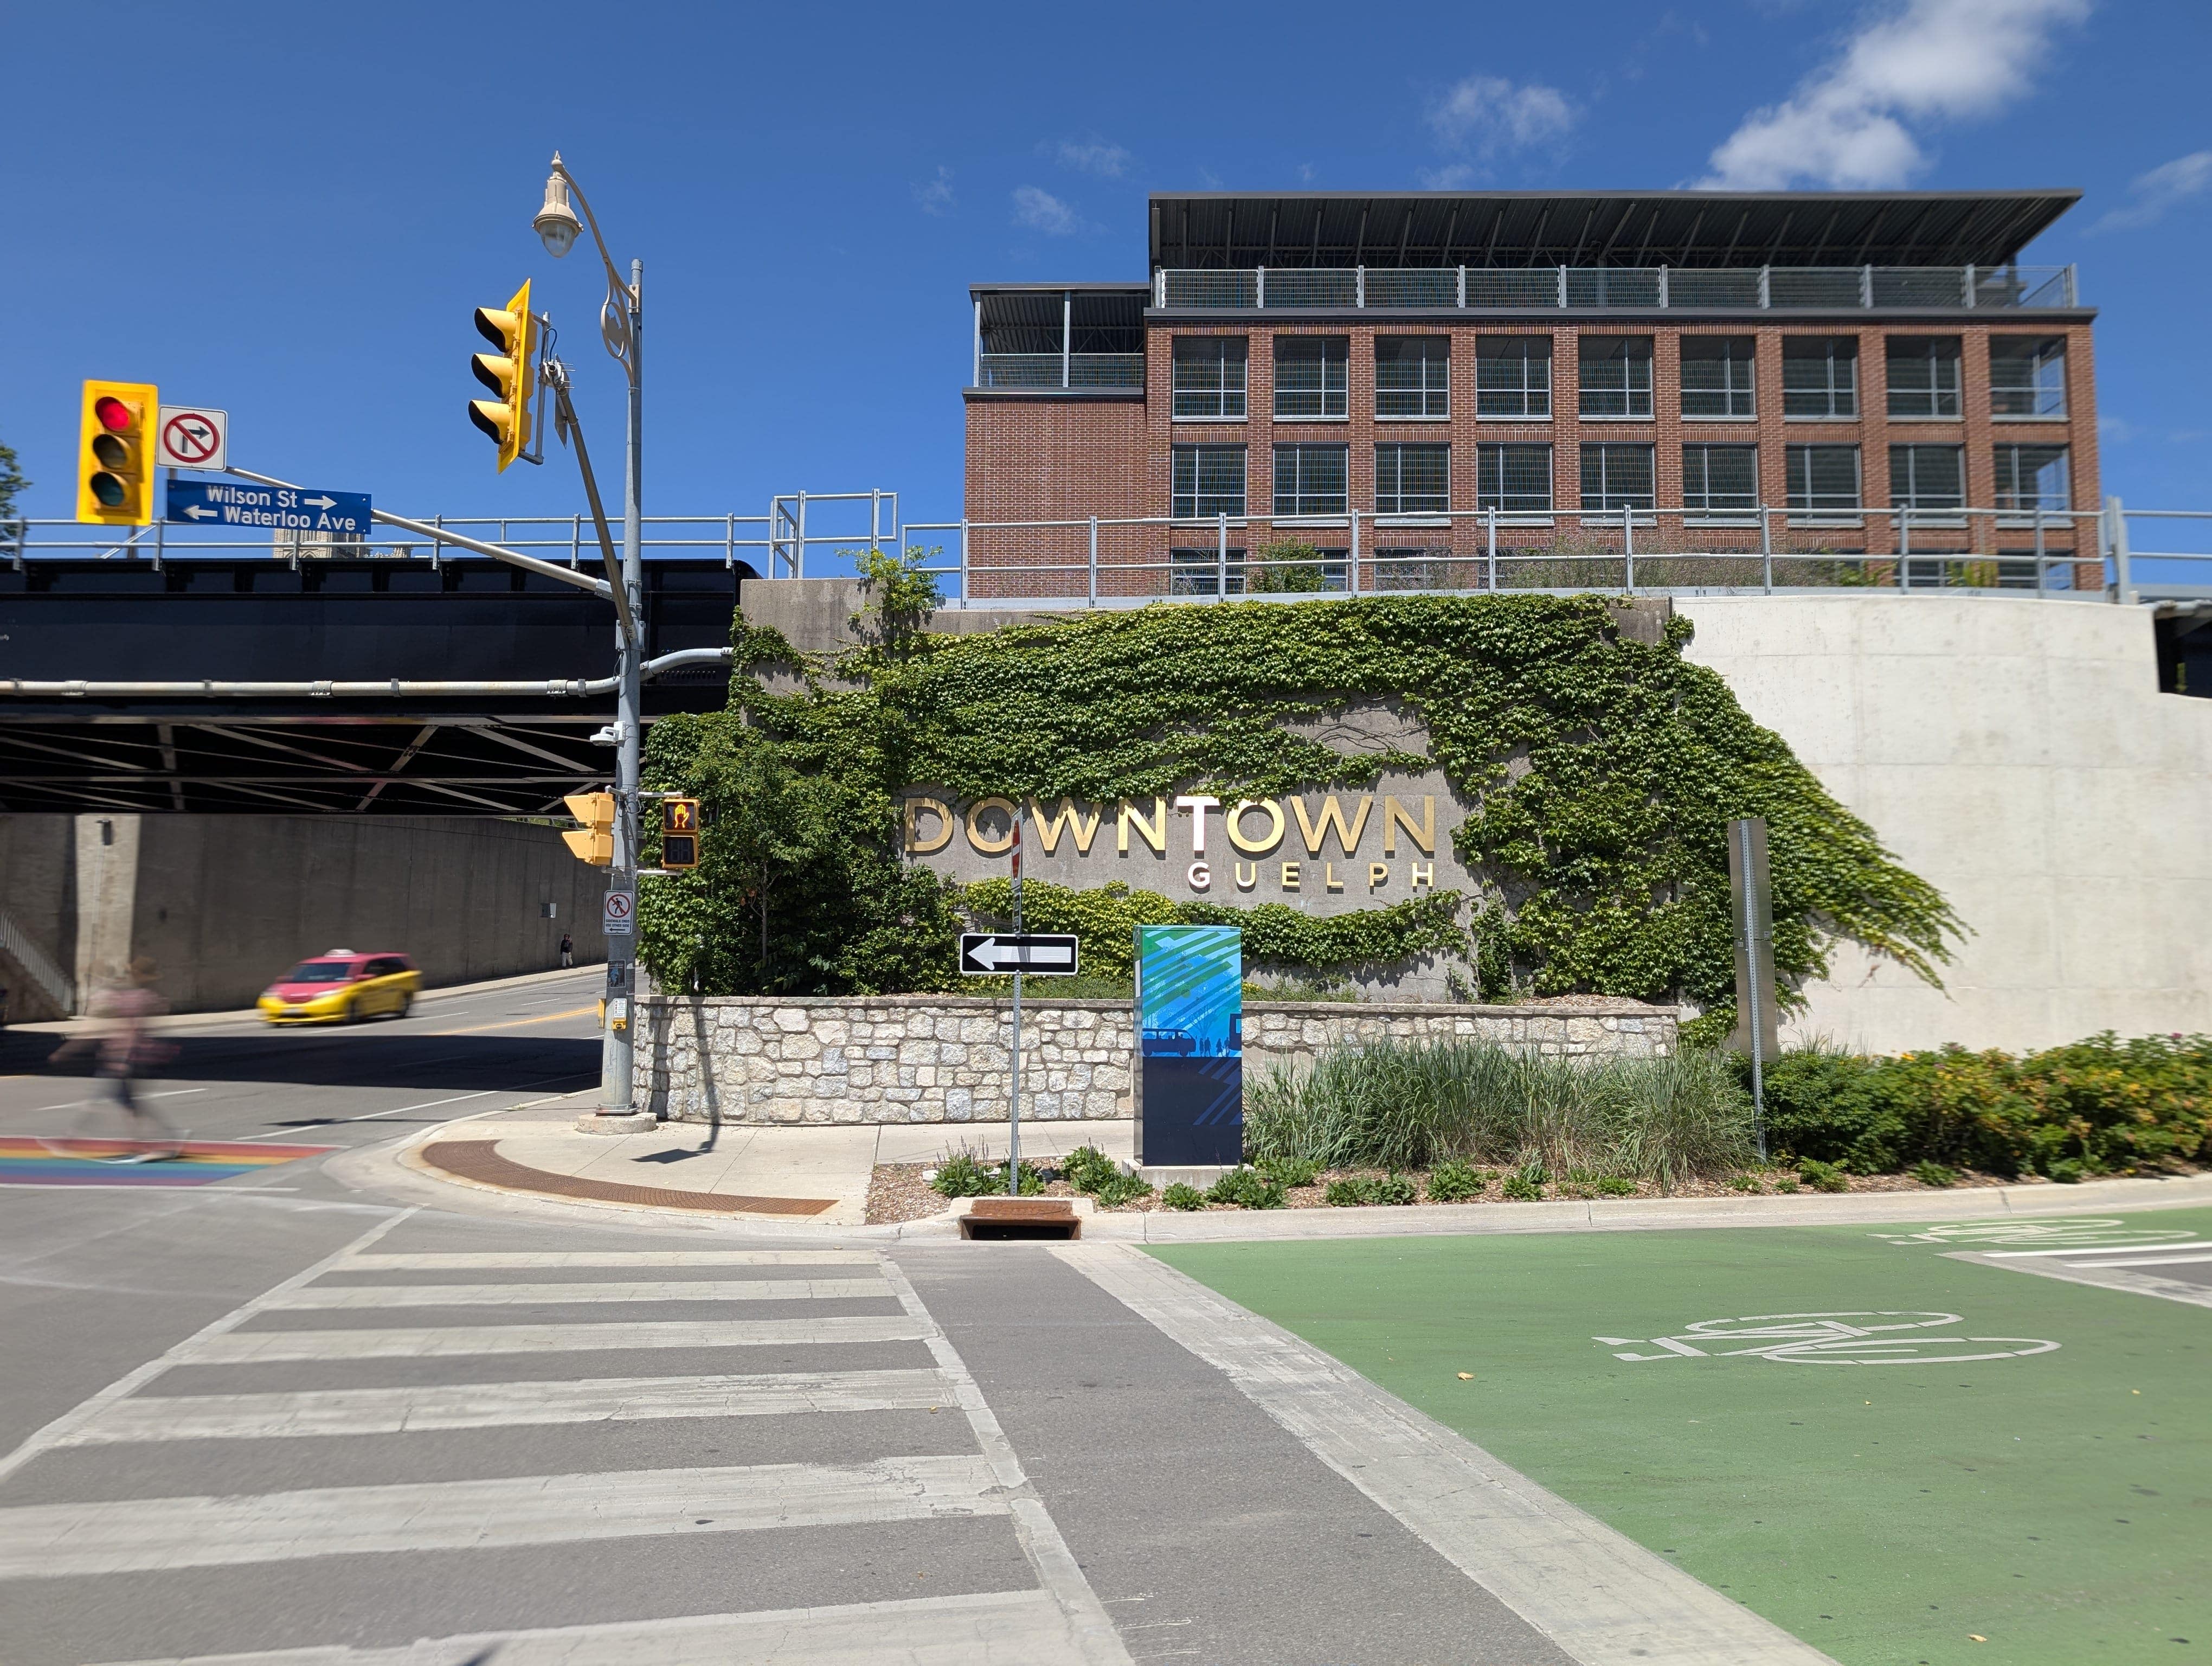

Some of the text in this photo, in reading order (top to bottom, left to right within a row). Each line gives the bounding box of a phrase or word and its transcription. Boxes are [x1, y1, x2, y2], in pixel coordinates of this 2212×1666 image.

[207, 485, 298, 508] Wilson St
[224, 505, 356, 531] Waterloo Ave
[905, 796, 1435, 853] DOWNTOWN
[1188, 862, 1433, 888] GUELPH
